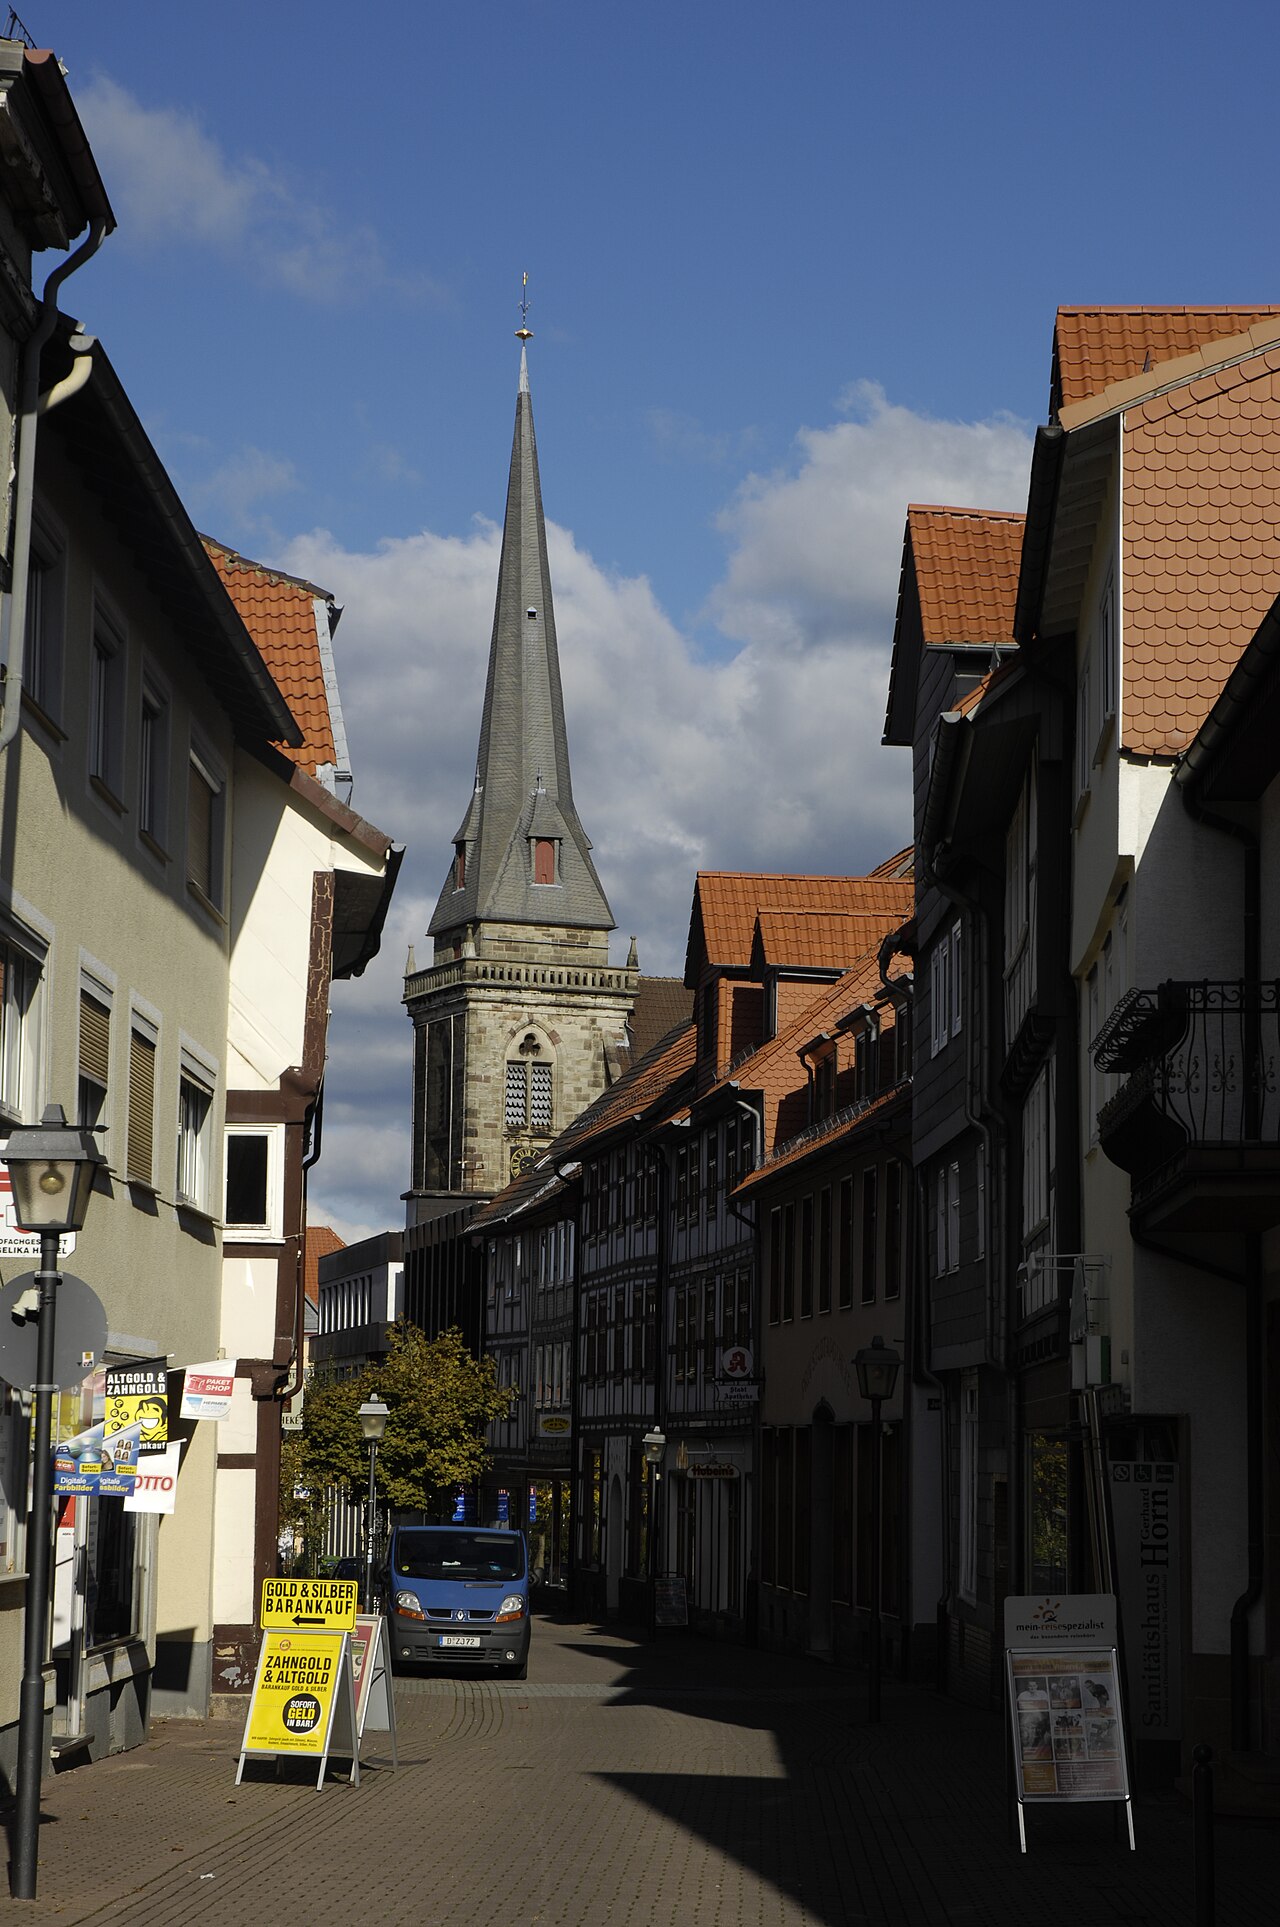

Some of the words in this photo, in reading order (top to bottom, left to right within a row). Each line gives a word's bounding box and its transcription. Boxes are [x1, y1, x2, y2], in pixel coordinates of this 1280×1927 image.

[107, 1373, 154, 1385] ALTGOLD
[157, 1372, 166, 1382] &
[107, 1384, 166, 1395] ZAHNGOLD
[54, 1484, 94, 1492] Farbbilder
[60, 1477, 87, 1486] Digitale
[1141, 1488, 1151, 1540] Gerhard
[1141, 1488, 1169, 1569] Horn
[266, 1582, 297, 1597] GOLD
[301, 1583, 310, 1597] &
[311, 1583, 354, 1599] SILBER
[265, 1598, 353, 1615] BARANKAUF
[1016, 1619, 1104, 1632] mein-reisespezialist
[1142, 1574, 1161, 1727] Sanitätshaus
[266, 1656, 332, 1670] ZAHNGOLD
[264, 1670, 273, 1682] &
[276, 1670, 329, 1684] ALTGOLD
[290, 1700, 317, 1708] SOFORT
[288, 1708, 316, 1720] GELD
[286, 1719, 295, 1727] IN
[295, 1719, 314, 1727] BAR!
